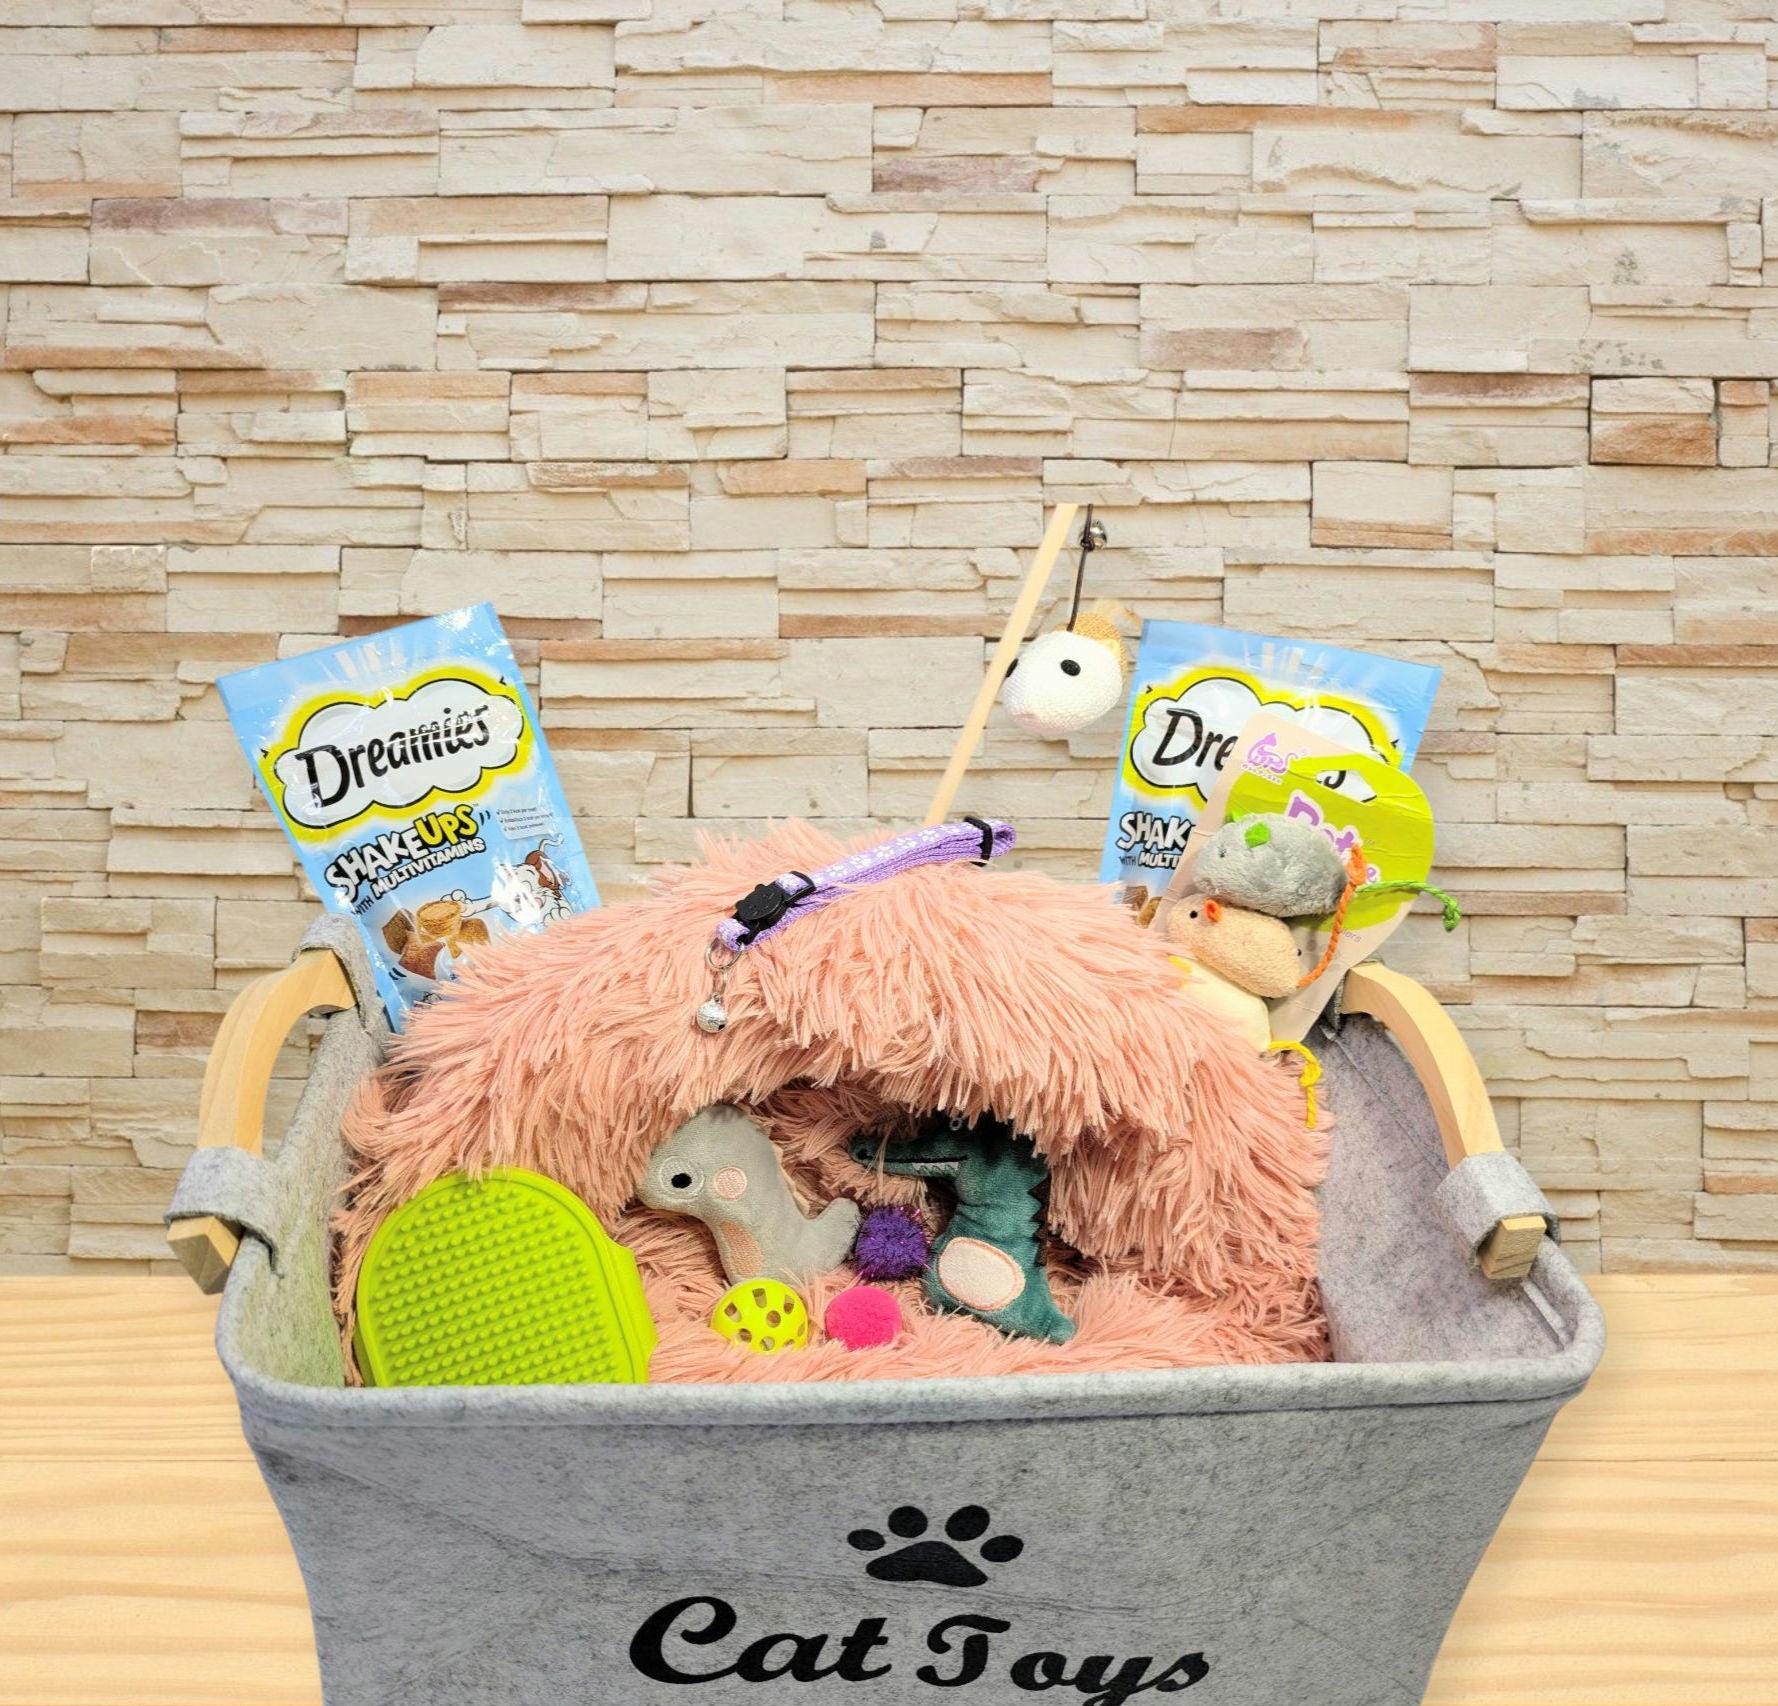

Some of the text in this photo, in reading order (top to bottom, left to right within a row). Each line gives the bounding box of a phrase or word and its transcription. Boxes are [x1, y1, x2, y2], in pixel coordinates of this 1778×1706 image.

[294, 704, 491, 808] Dreamies
[1115, 810, 1196, 853] SHAK
[1137, 850, 1181, 870] MULTI
[371, 836, 487, 900] MULTIVITAMINS
[628, 1596, 1210, 1706] Cat Toys
